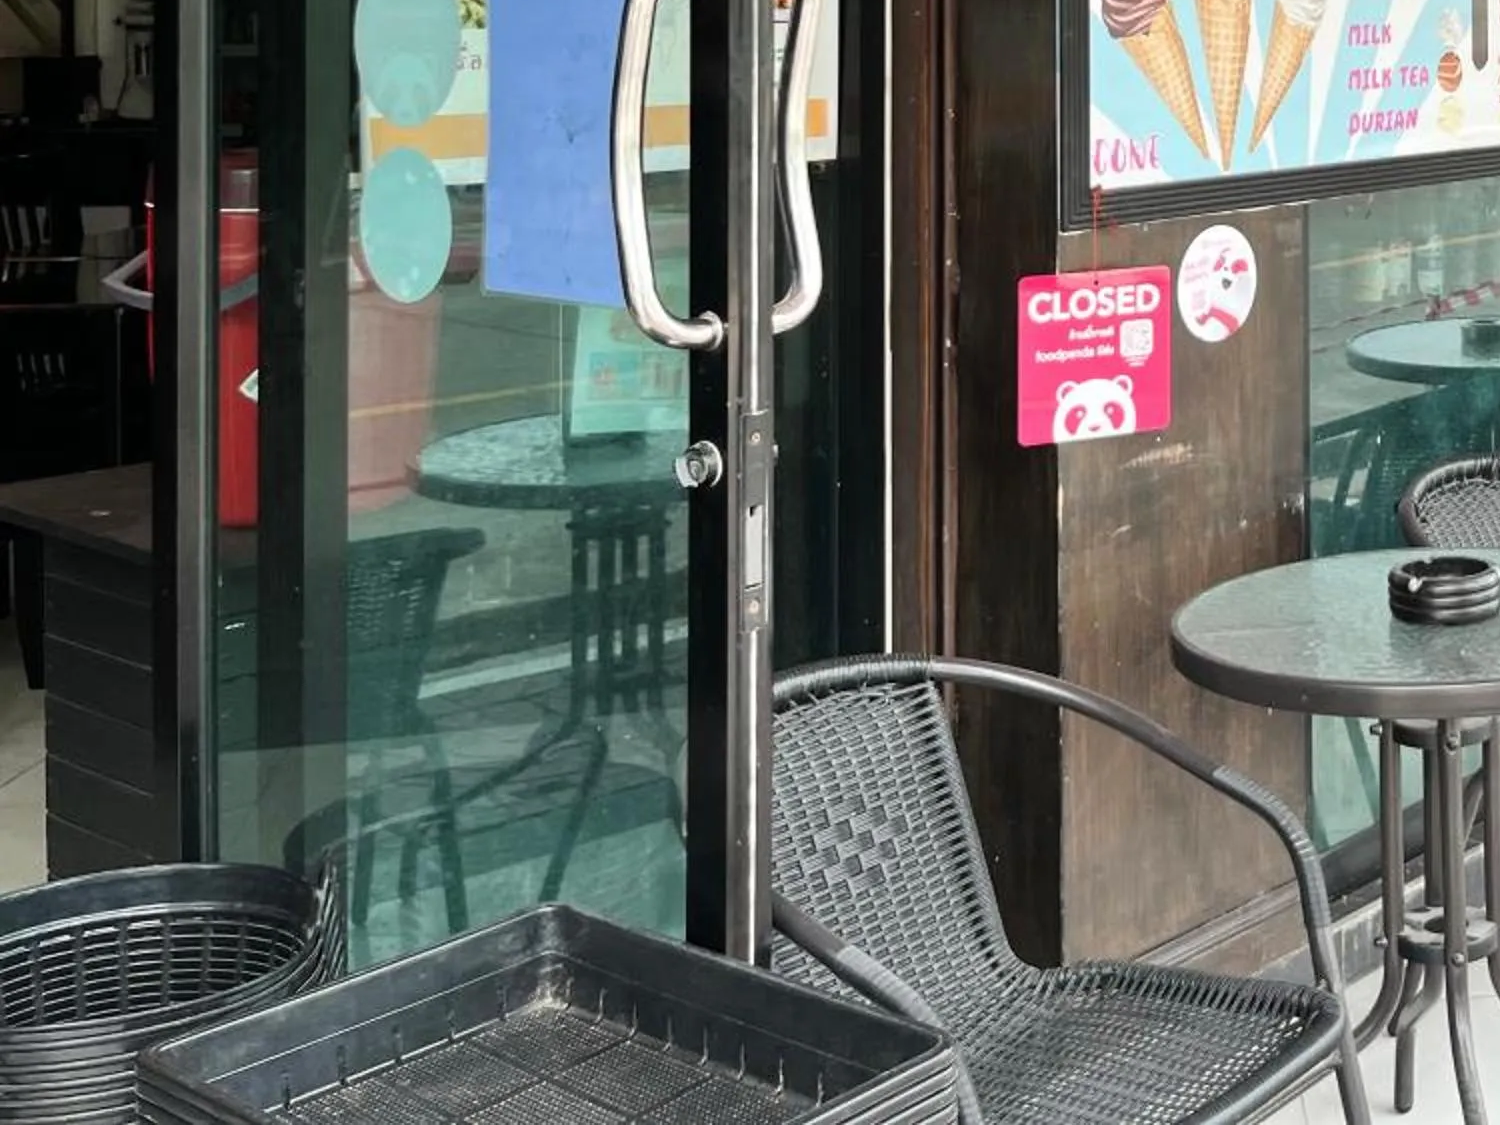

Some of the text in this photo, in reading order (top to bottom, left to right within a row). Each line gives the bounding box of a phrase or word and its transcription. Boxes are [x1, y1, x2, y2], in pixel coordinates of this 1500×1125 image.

[1348, 23, 1392, 46] MILK
[1348, 65, 1430, 90] MILK TEA
[1348, 108, 1418, 137] DURIAN
[1092, 134, 1160, 173] CONE
[1027, 283, 1161, 324] CLOSED
